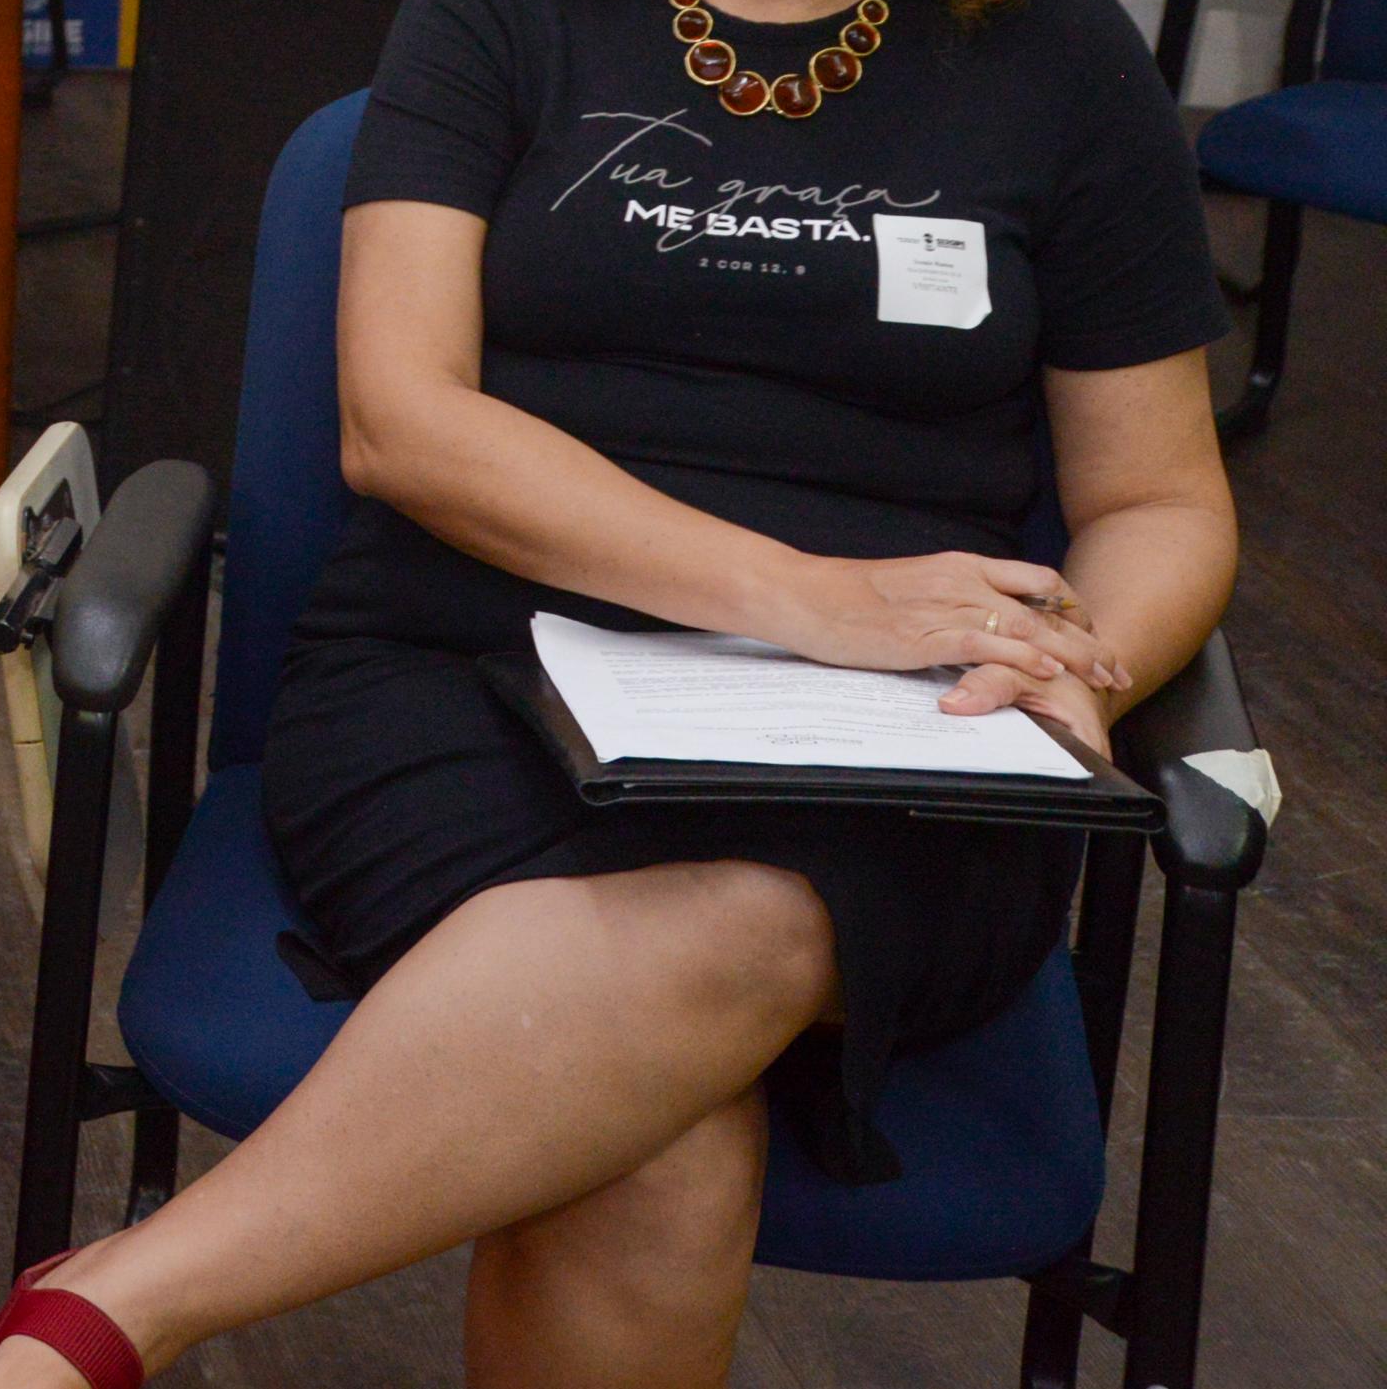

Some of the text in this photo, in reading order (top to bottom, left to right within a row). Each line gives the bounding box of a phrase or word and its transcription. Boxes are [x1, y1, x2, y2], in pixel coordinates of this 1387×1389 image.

[549, 108, 941, 252] Tua graça
[624, 199, 872, 242] ME BASTA.
[699, 258, 708, 268] 2
[717, 259, 753, 272] COR
